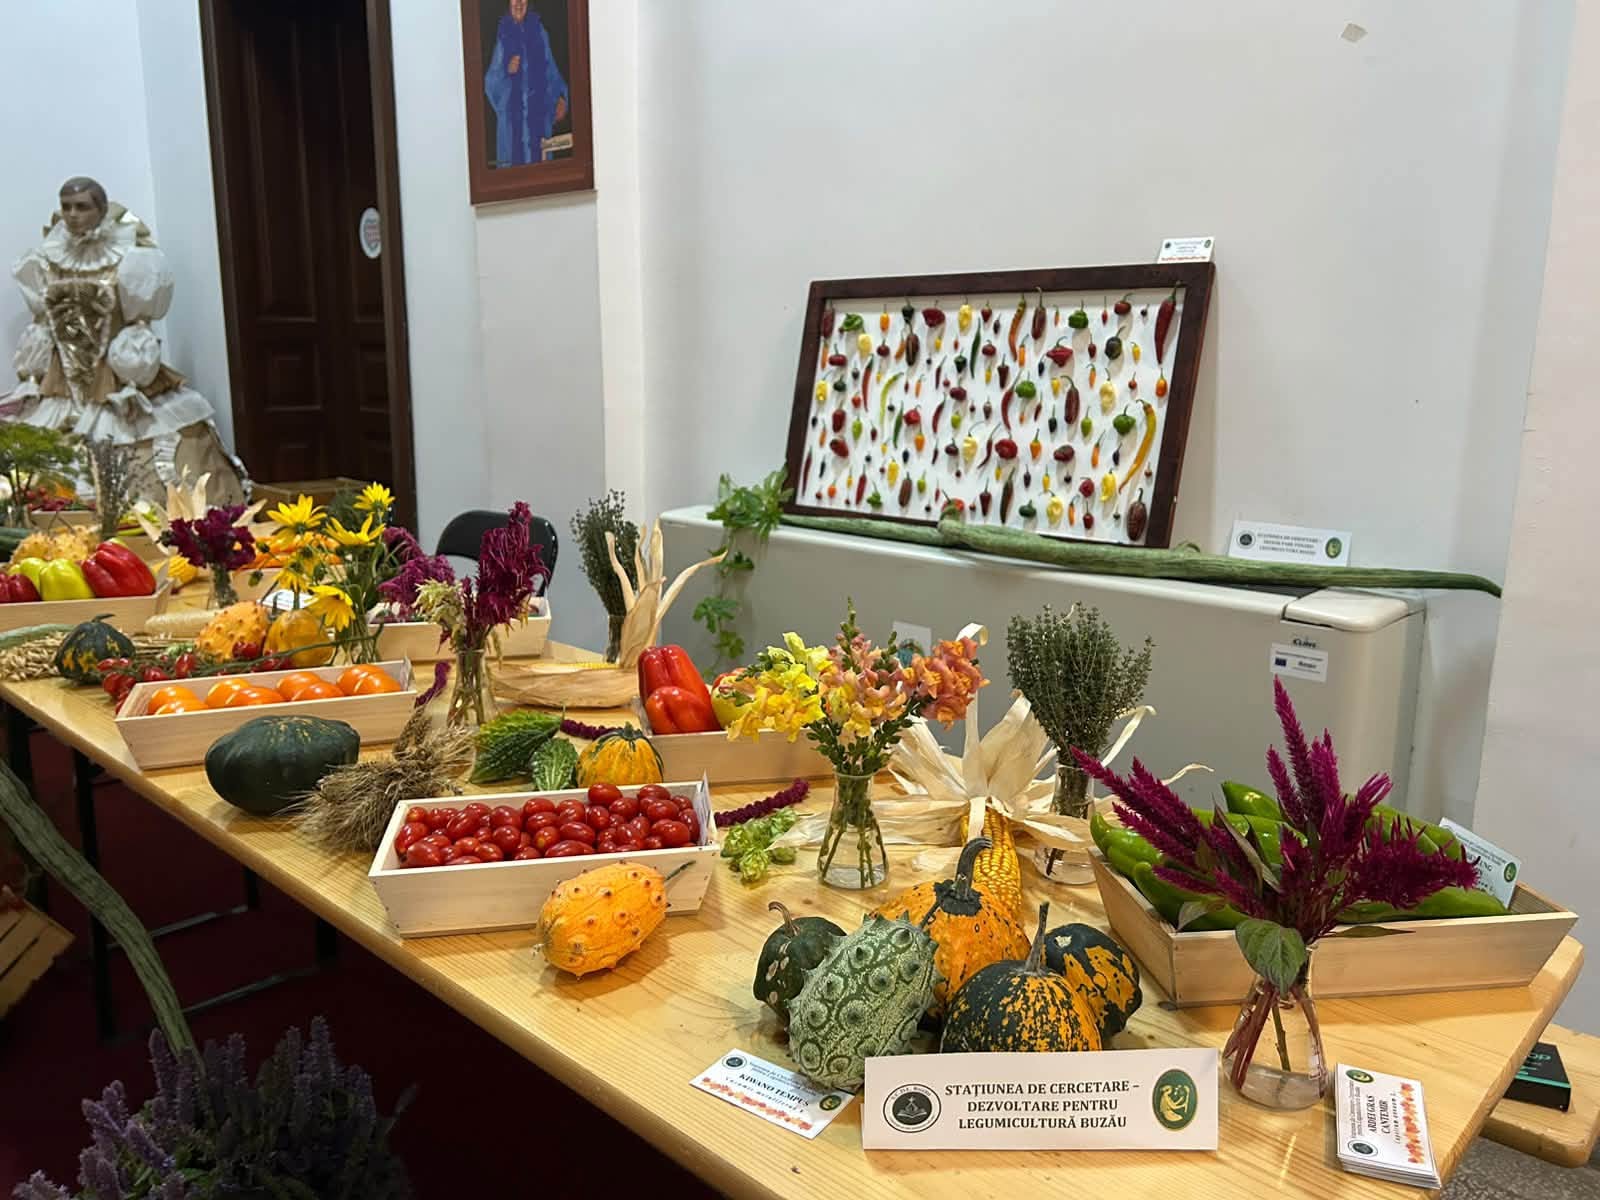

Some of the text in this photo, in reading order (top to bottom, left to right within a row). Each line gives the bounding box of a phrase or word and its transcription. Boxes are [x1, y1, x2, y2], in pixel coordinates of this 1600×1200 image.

[739, 1073, 775, 1092] KIWANO
[775, 1088, 809, 1107] TEMPUS
[1028, 1082, 1047, 1095] DE
[1049, 1080, 1130, 1095] CERCETARE
[967, 1099, 1118, 1113] DEZVOLTARE PENTRU
[959, 1112, 1128, 1129] LEGUMICULTURĂ BUZĂU
[1378, 1100, 1391, 1134] CANTEMIR
